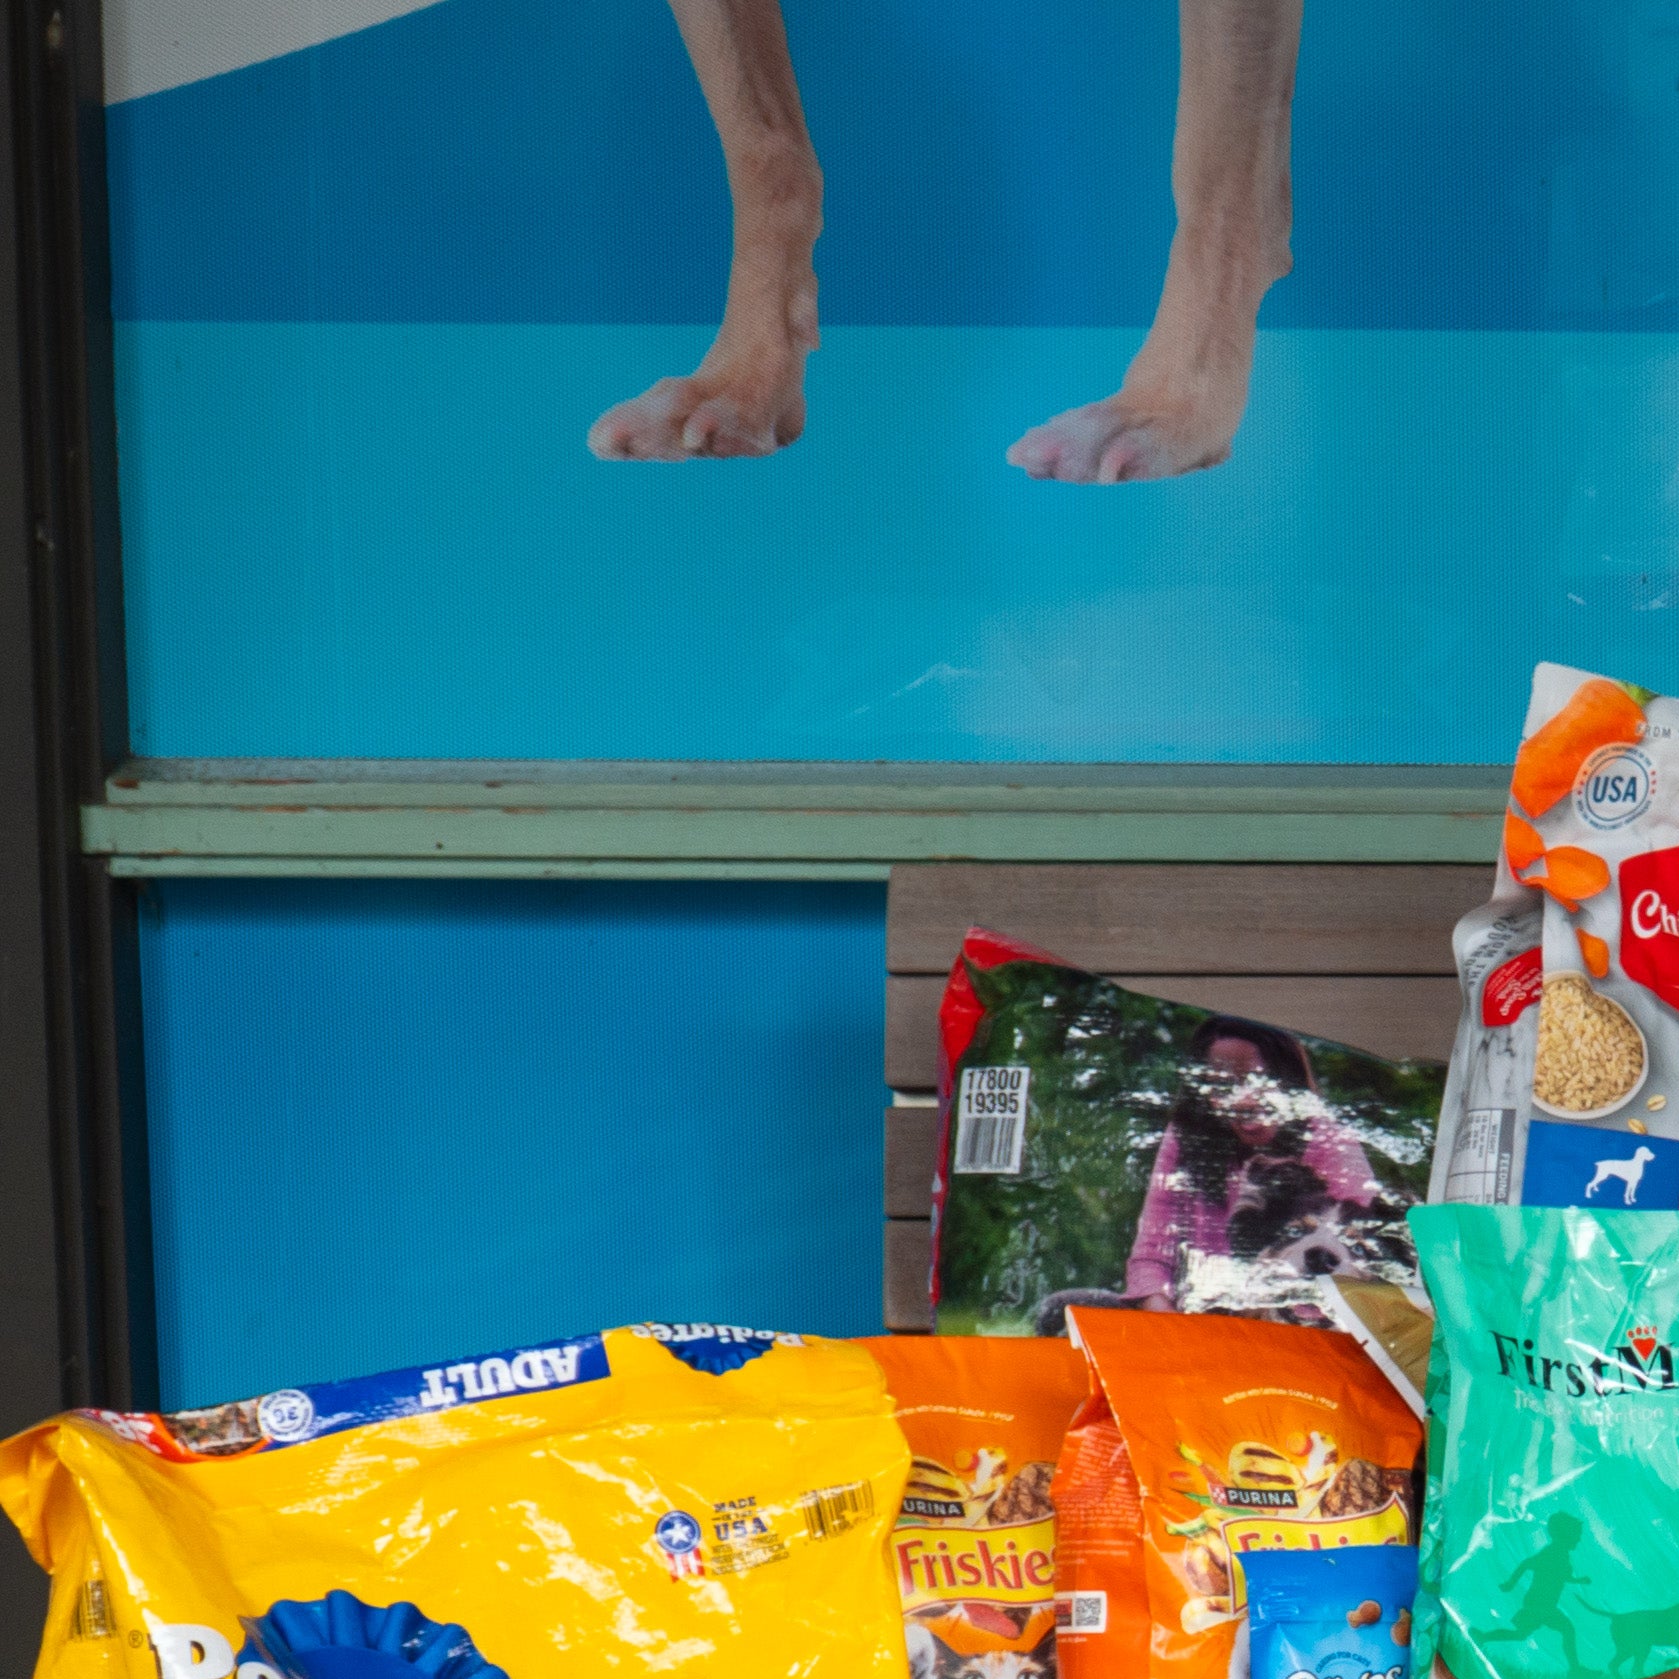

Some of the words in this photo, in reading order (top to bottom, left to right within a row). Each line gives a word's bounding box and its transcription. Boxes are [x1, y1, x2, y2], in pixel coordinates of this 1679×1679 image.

[1593, 776, 1637, 804] USA
[966, 1069, 1023, 1090] 17800
[965, 1093, 1020, 1114] 19395
[421, 1344, 581, 1408] ADULT
[1227, 1488, 1295, 1506] PURINA
[900, 1539, 1056, 1594] Friskie
